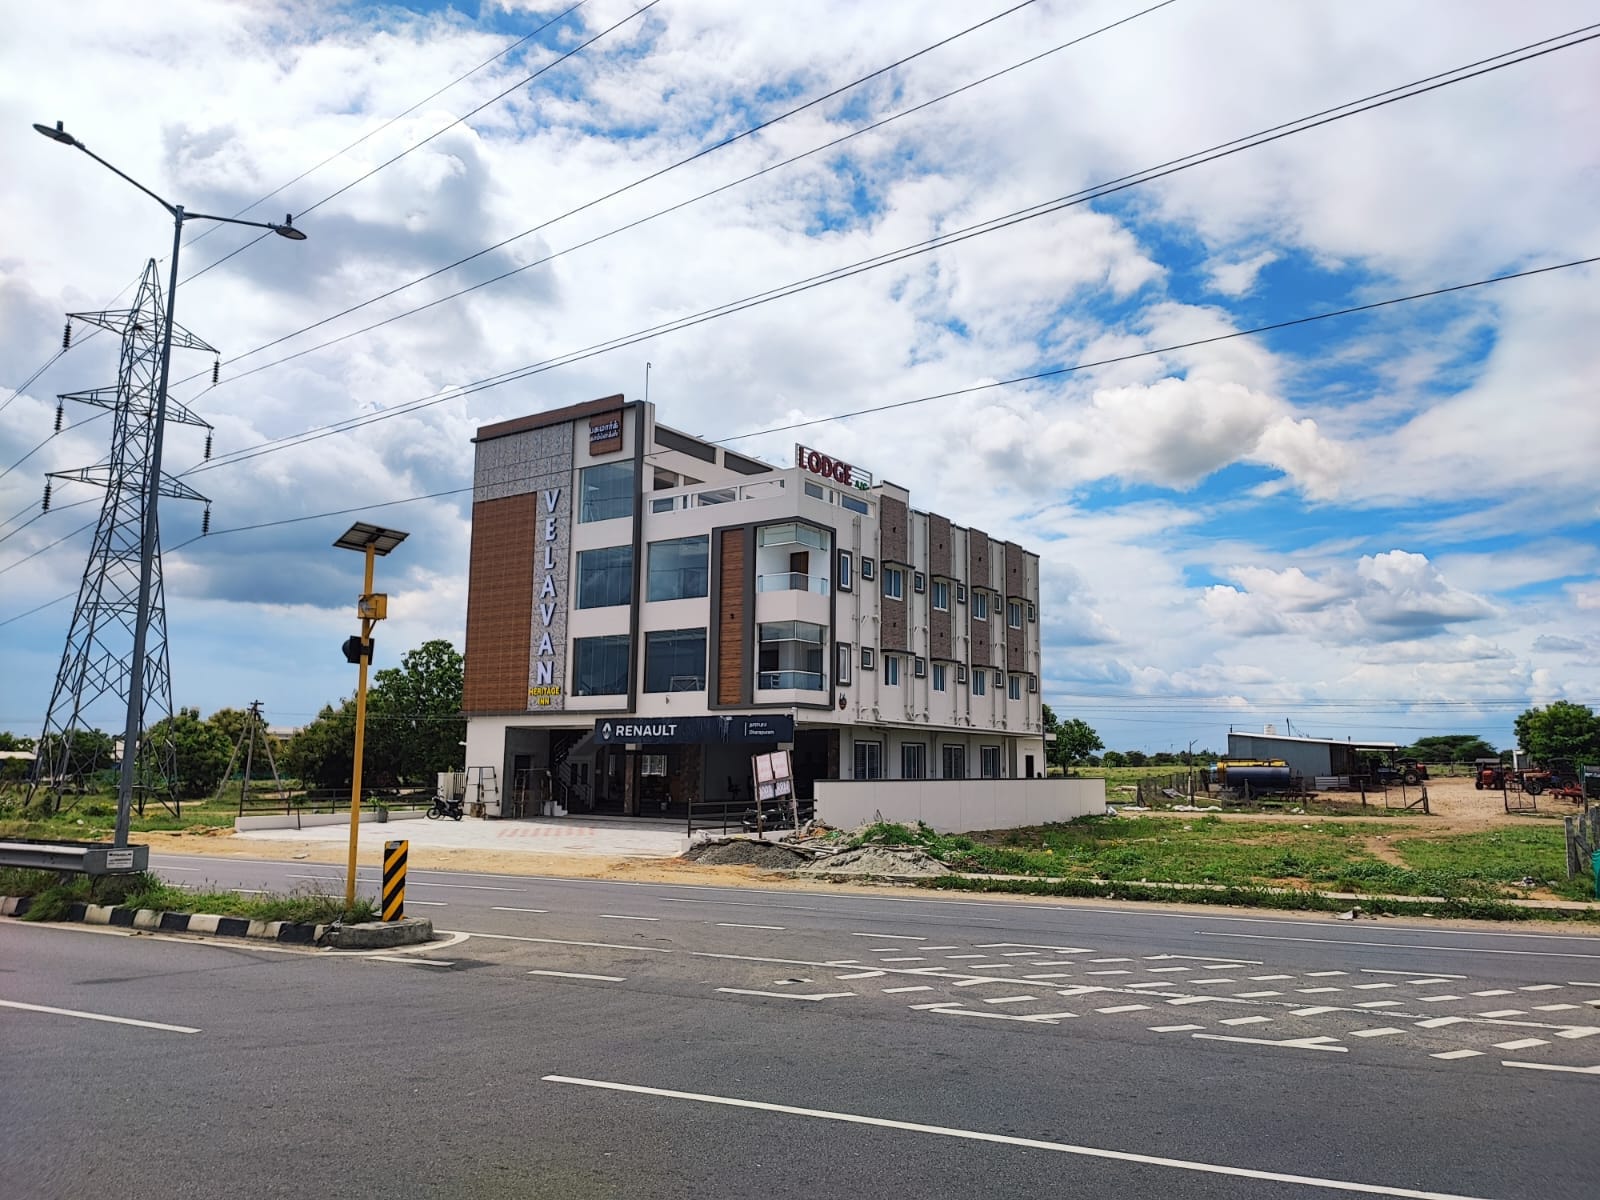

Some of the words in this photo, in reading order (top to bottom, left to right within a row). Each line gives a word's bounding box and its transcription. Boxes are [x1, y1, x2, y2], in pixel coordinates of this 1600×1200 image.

[799, 447, 852, 486] LODGE
[538, 489, 560, 685] VELAVAN
[529, 687, 560, 696] HERITAGE
[538, 697, 550, 705] INN
[615, 724, 677, 737] RENAULT
